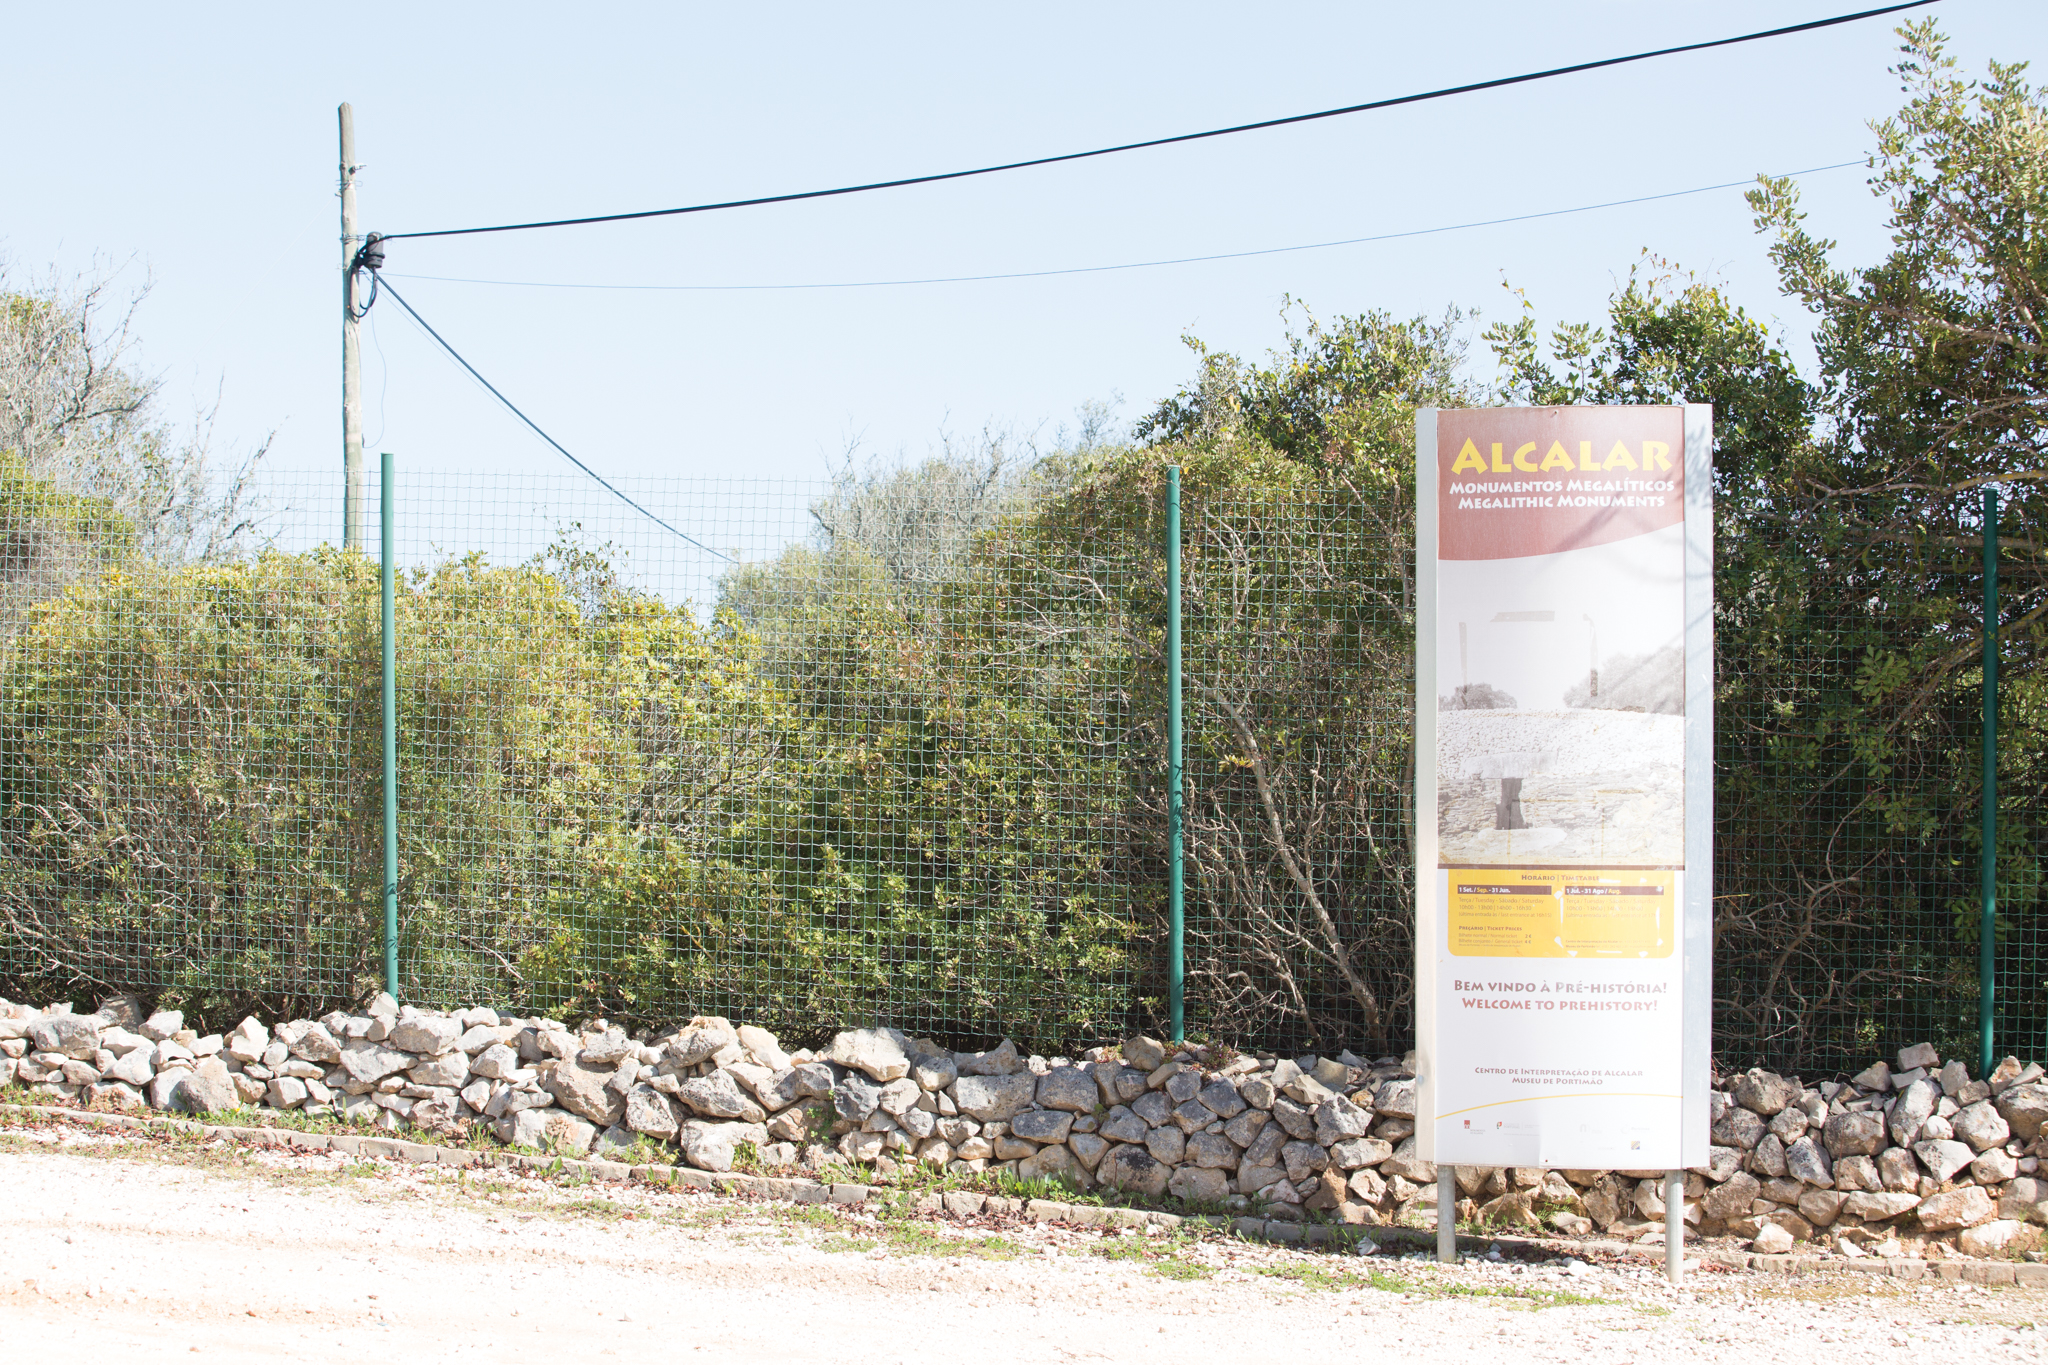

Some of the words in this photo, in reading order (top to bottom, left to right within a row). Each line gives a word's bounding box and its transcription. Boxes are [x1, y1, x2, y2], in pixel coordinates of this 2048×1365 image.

[1451, 437, 1673, 475] ALCALAR
[1449, 481, 1563, 494] MONUMENTOS
[1566, 477, 1675, 492] MEGALÍTICOS
[1458, 497, 1553, 509] MEGALITHIC
[1557, 495, 1665, 508] MONUMENTS
[1454, 980, 1484, 992] BEM
[1488, 982, 1536, 992] VINDO
[1540, 980, 1550, 992] À
[1555, 980, 1667, 994] PRÉ-HISTÓRIA!
[1462, 997, 1532, 1010] WELCOME
[1535, 1000, 1554, 1010] TO
[1559, 1000, 1658, 1011] PREHISTORY!
[1475, 1066, 1506, 1075] CENTRO
[1521, 1068, 1589, 1077] INTERPRETAÇÃO
[1556, 1077, 1603, 1085] PORTIMÃO
